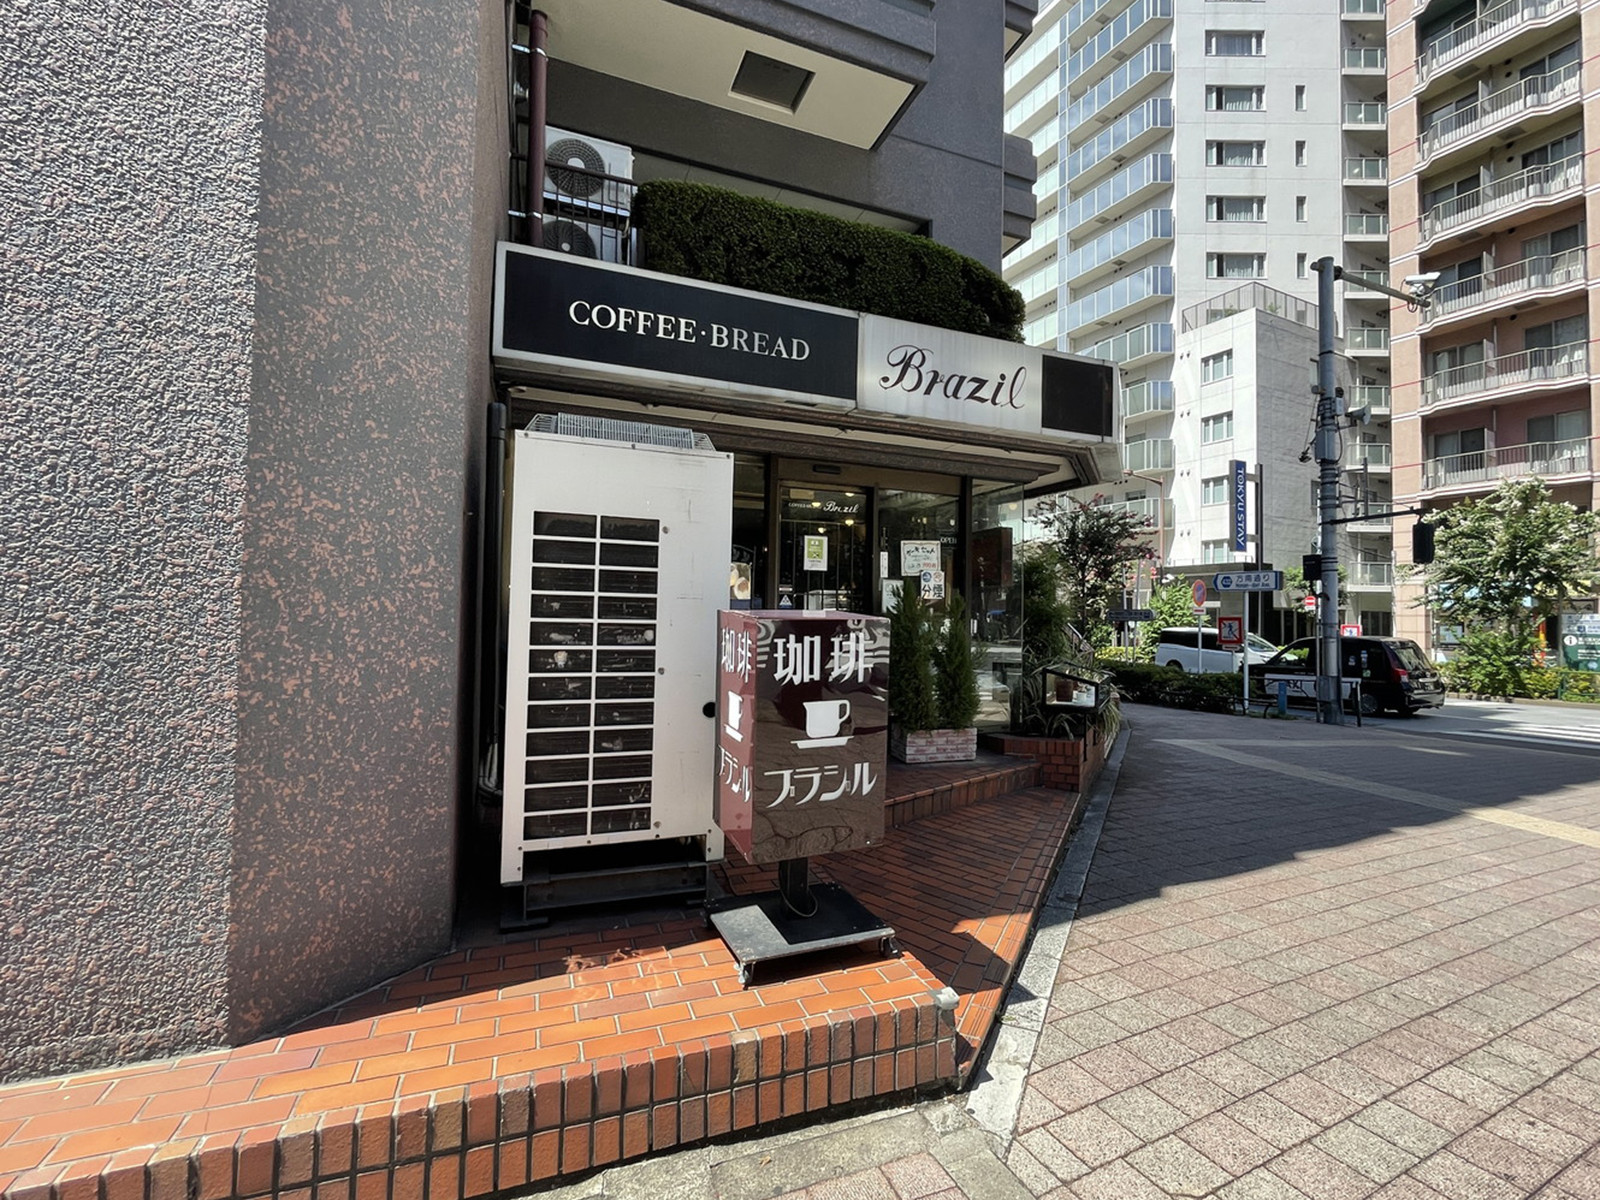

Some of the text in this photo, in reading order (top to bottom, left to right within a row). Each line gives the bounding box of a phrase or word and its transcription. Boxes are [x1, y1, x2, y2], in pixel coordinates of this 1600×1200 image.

[879, 344, 1028, 410] Brazil
[1236, 467, 1245, 547] TOKYU STAY
[721, 628, 753, 683] 珈琲
[773, 632, 875, 686] 珈琲
